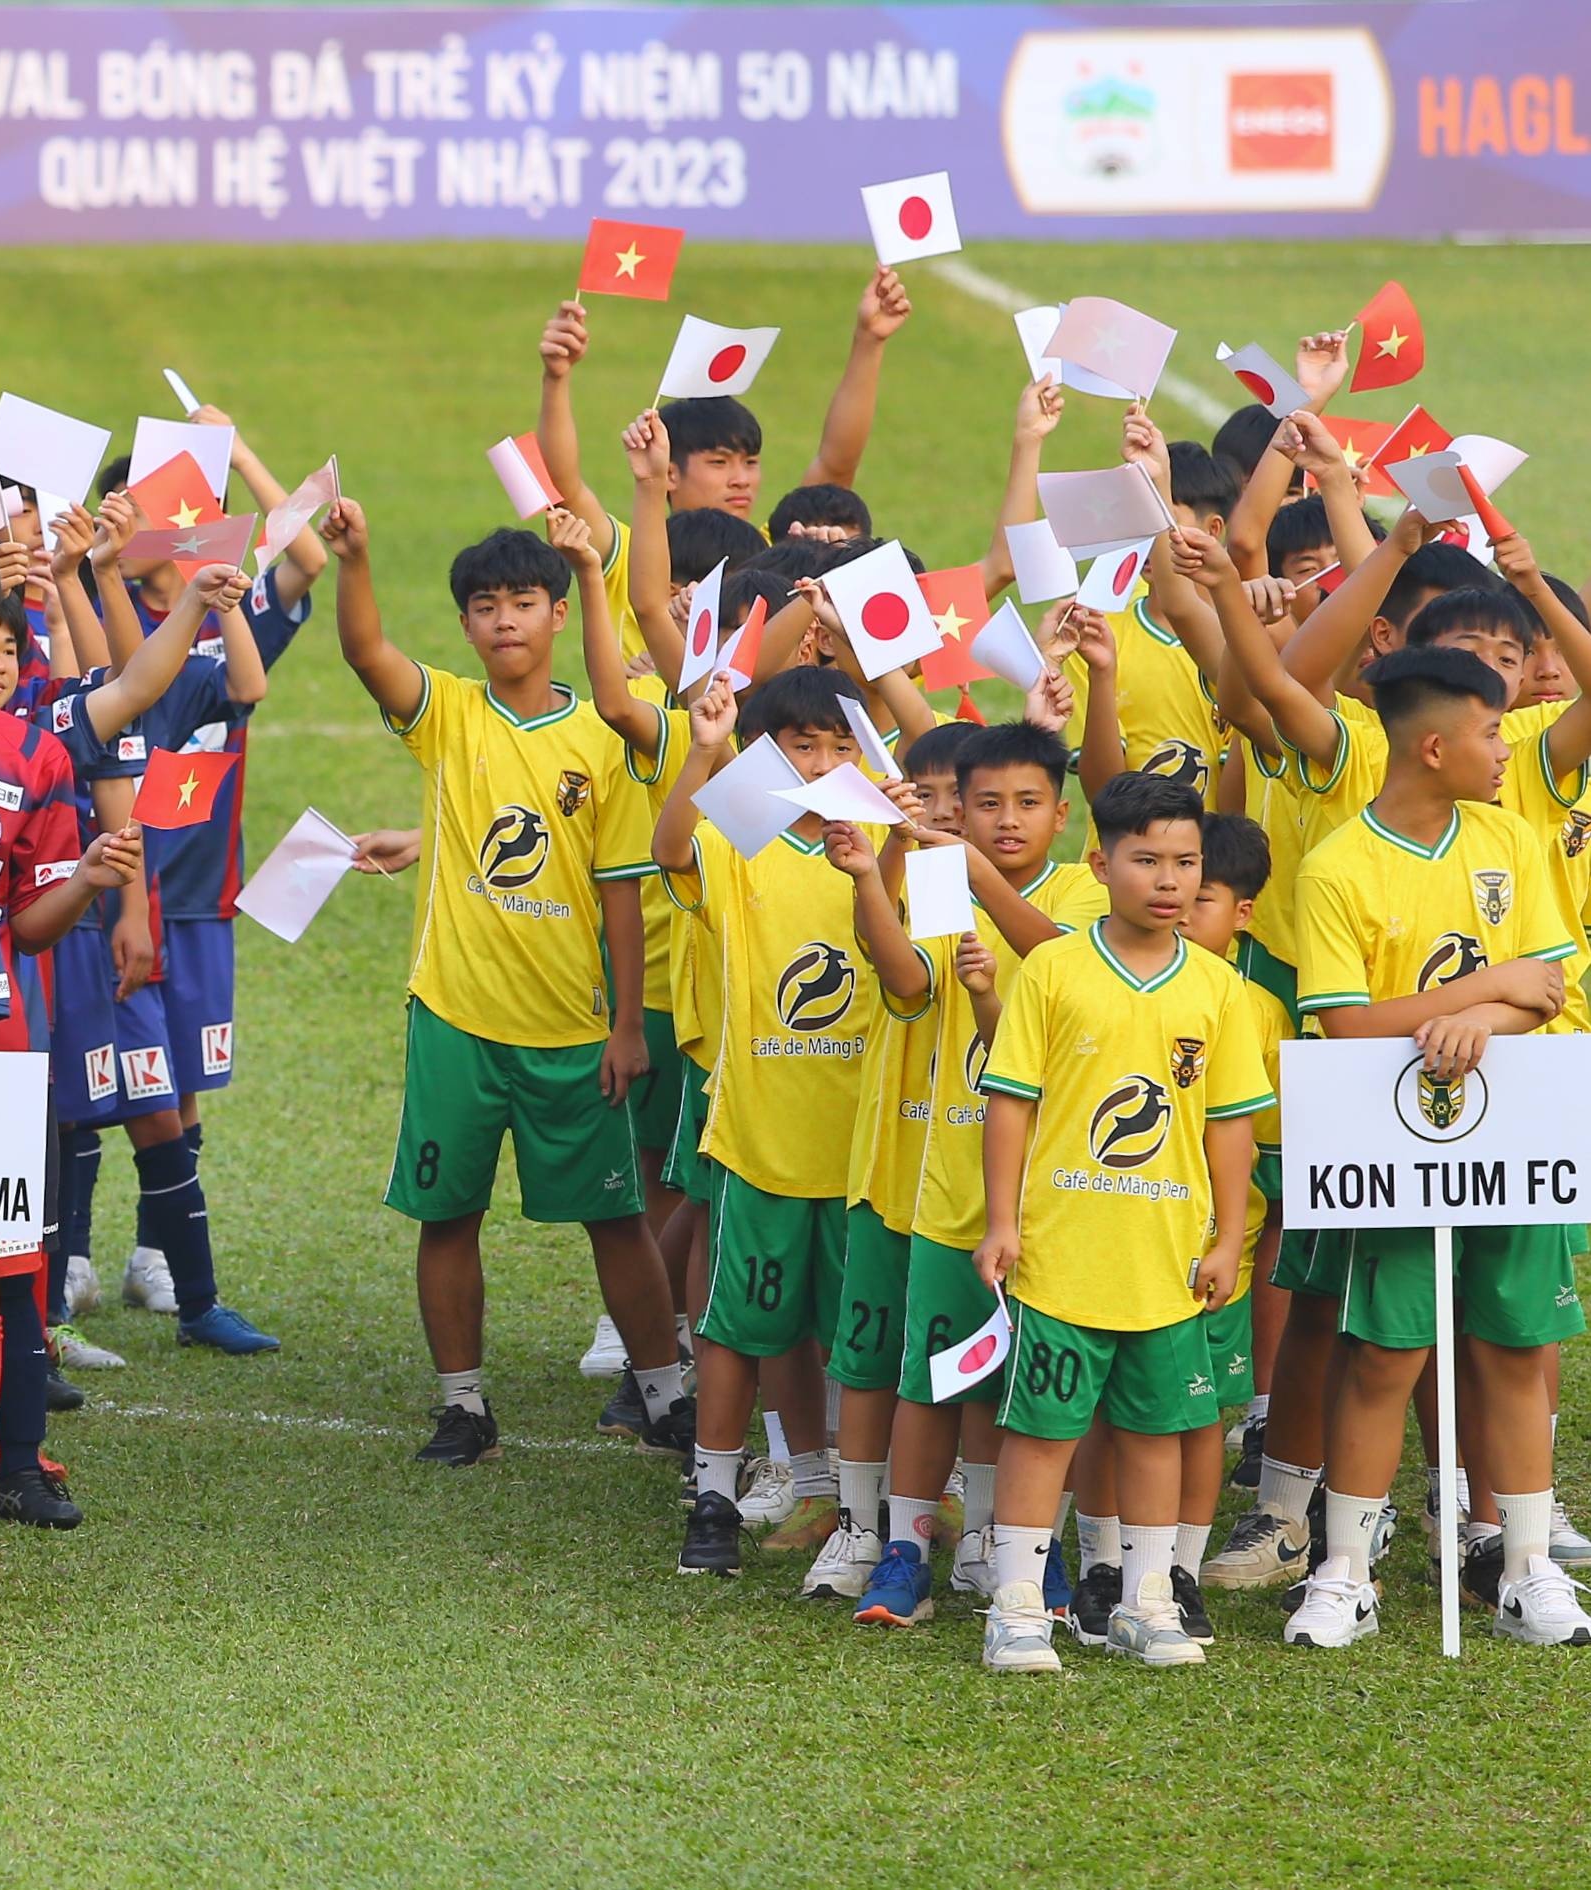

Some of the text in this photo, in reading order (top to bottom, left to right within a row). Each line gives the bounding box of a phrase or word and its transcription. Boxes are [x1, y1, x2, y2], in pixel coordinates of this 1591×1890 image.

[97, 39, 256, 120] BÓNG
[269, 38, 353, 119] ĐÁ
[580, 41, 722, 132] NIỆM
[738, 50, 811, 121] 50
[1417, 75, 1591, 157] HAGL
[40, 127, 748, 220] QUAN HỆ VIỆT NHẬT 2023
[751, 1036, 780, 1055] Café
[784, 1036, 803, 1055] de
[808, 1036, 851, 1058] Măng
[415, 1140, 441, 1190] 8
[1053, 1169, 1088, 1190] Café
[1091, 1172, 1112, 1192] de
[1309, 1159, 1577, 1210] KON TUM FC
[745, 1256, 783, 1312] 18
[846, 1300, 890, 1354] 21
[1028, 1341, 1082, 1404] 80
[1189, 1386, 1215, 1397] MIRA
